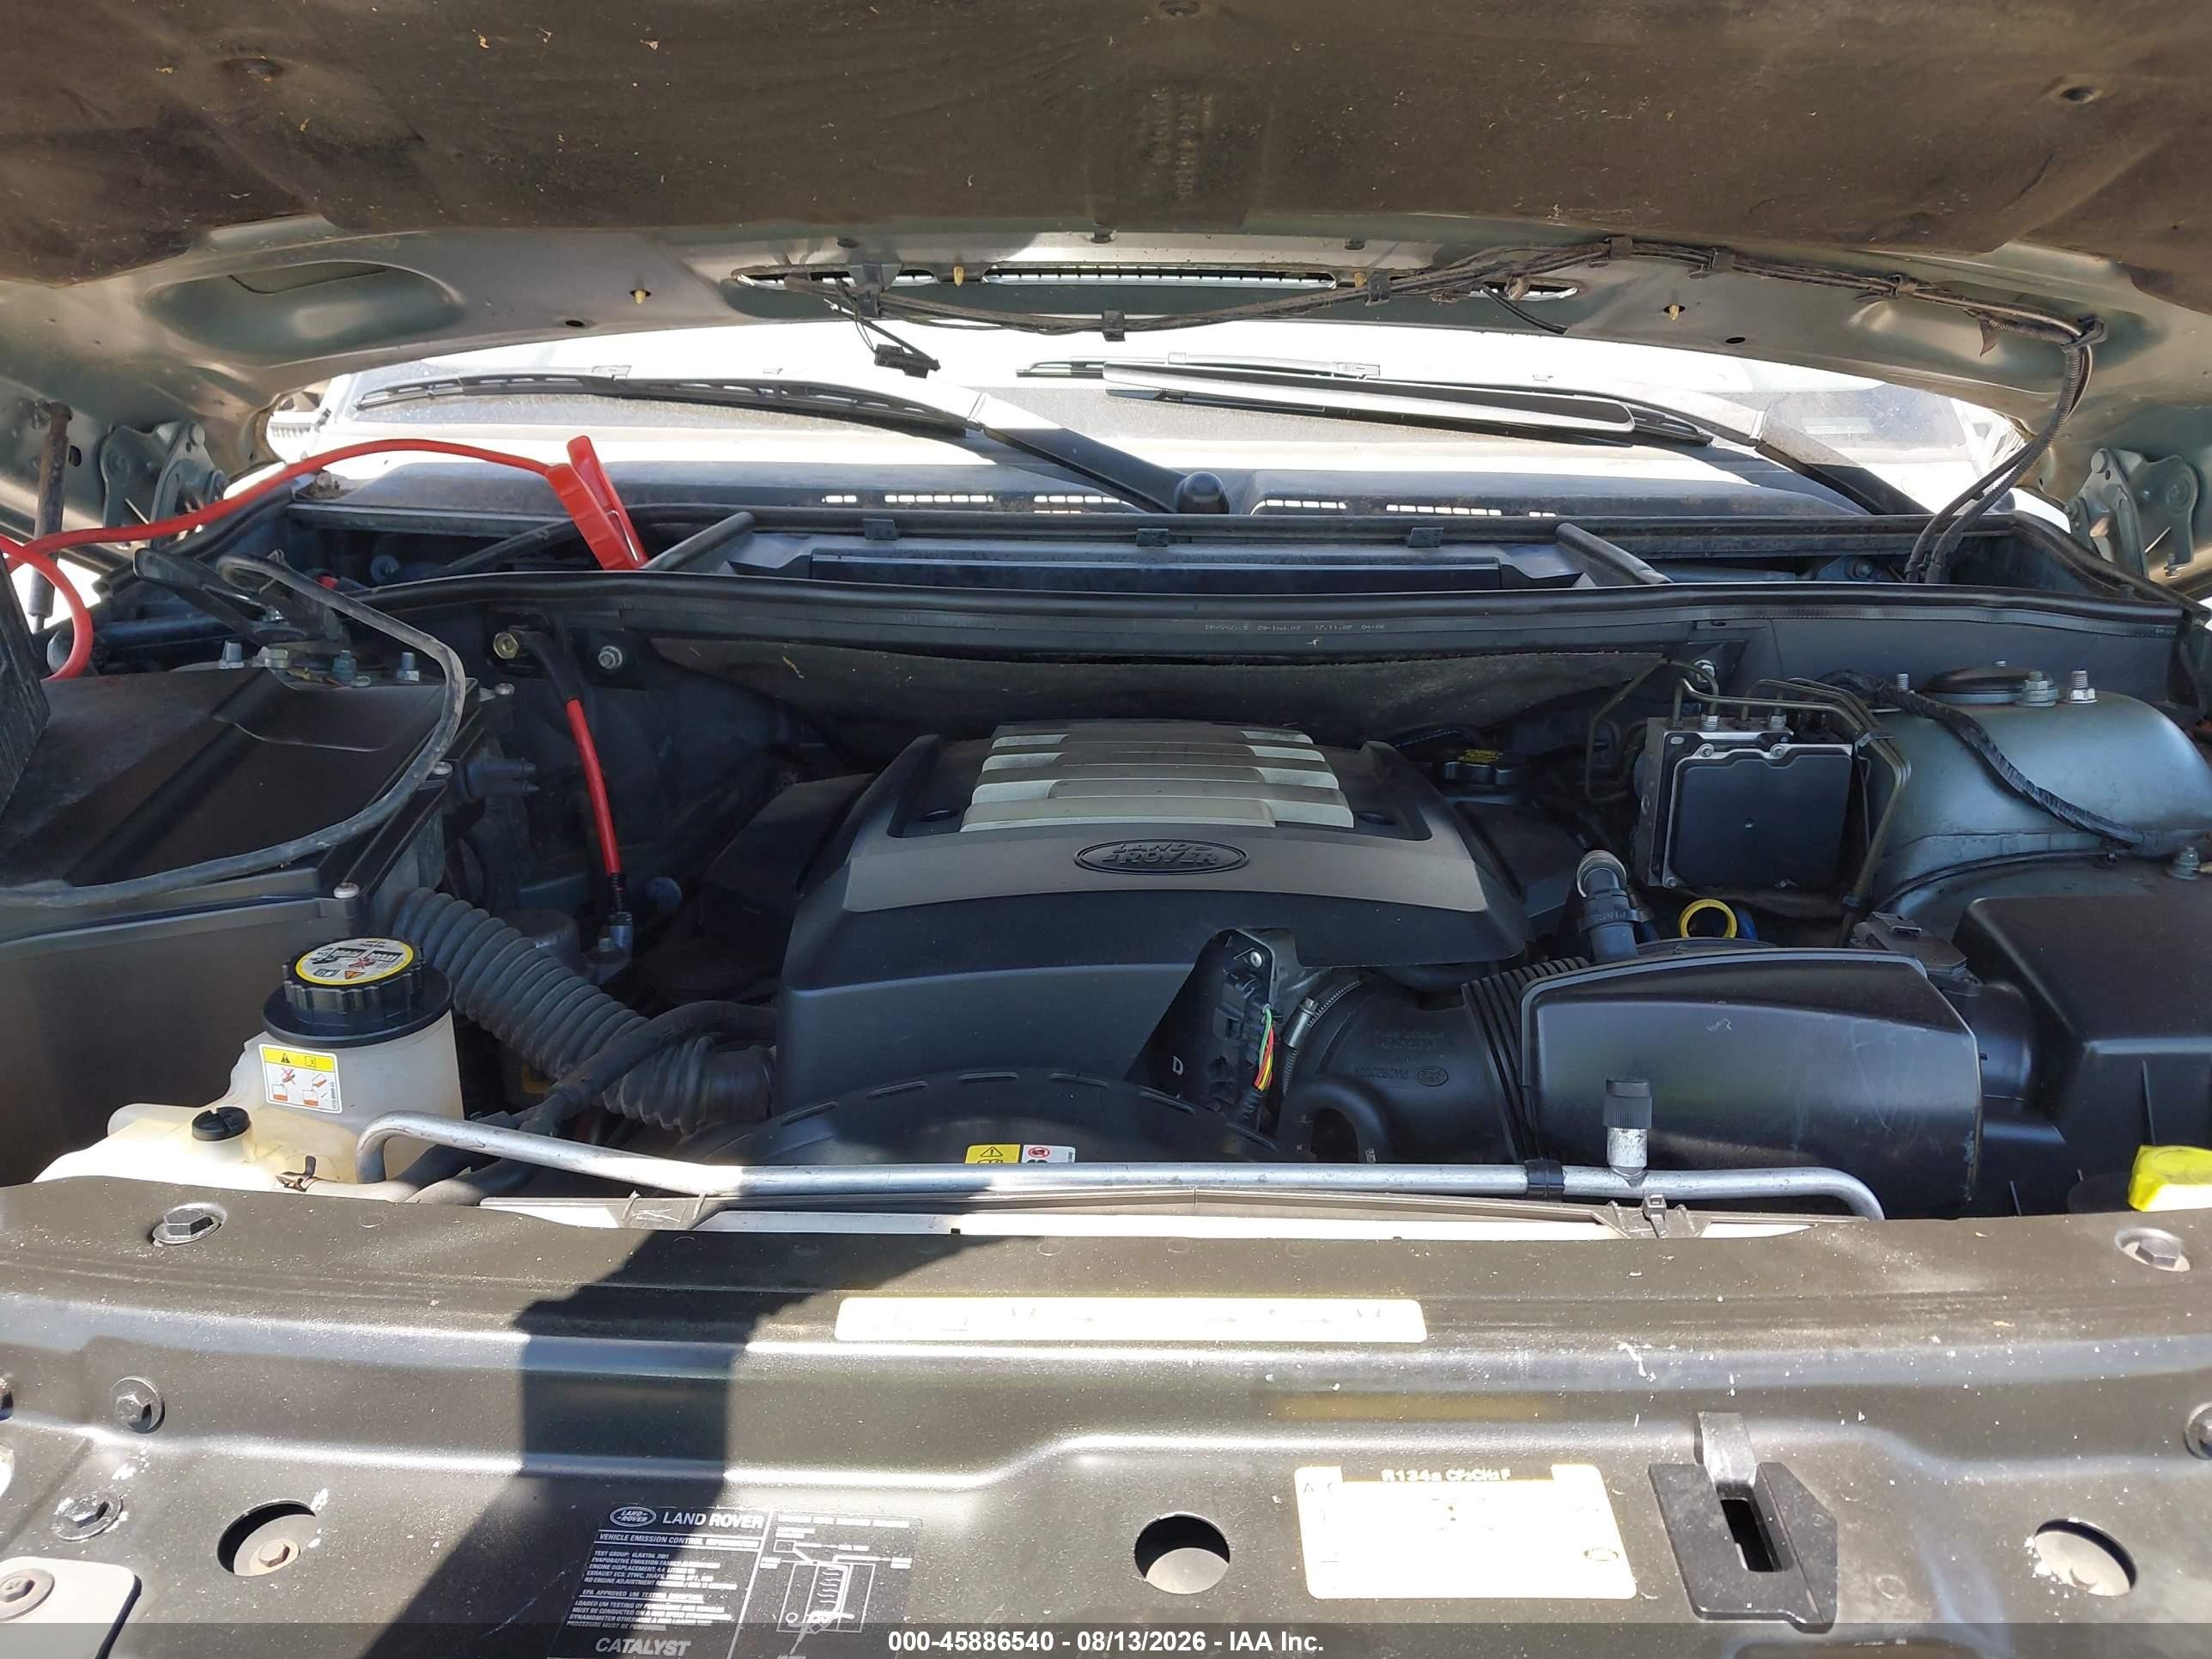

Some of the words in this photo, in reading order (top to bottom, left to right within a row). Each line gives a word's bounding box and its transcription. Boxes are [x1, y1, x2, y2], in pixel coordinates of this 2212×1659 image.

[662, 1511, 707, 1526] LAND
[708, 1513, 765, 1529] ROVER
[599, 1533, 629, 1541] VEHICLE
[629, 1534, 668, 1544] EMISSION
[595, 1636, 691, 1657] CATALYST
